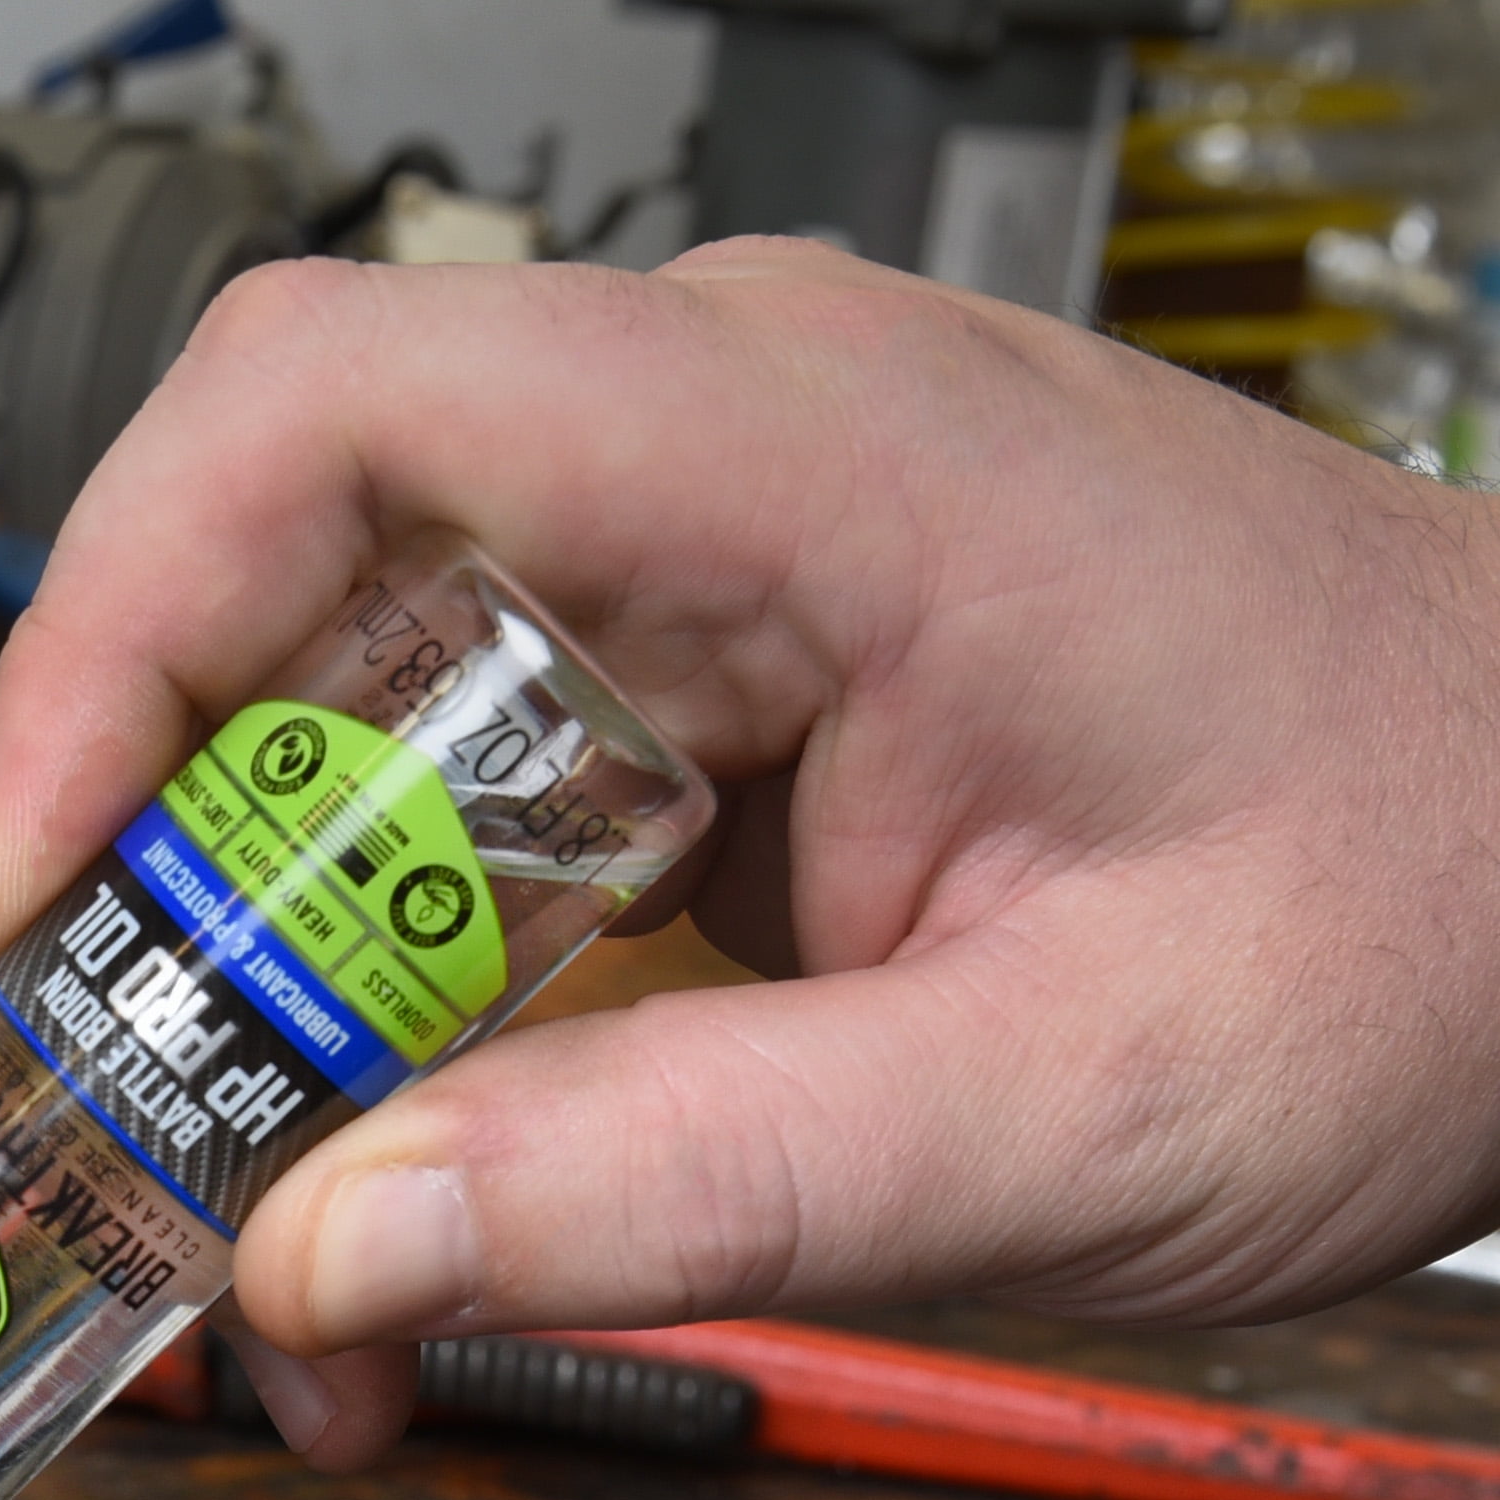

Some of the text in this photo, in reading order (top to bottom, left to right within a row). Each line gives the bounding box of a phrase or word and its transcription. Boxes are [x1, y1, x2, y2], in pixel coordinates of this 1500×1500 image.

[448, 704, 533, 786] OZ
[197, 792, 234, 833] 100%
[384, 821, 411, 848] MADE
[515, 759, 583, 839] FL
[554, 811, 631, 885] 1.8
[235, 839, 337, 942] HEAVY-DUTY
[140, 835, 351, 1056] LUBRICANT & PROTECTANT
[58, 882, 306, 1145] HP PRO OIL
[361, 968, 435, 1041] ODORLESS
[34, 966, 214, 1151] BATTLE BORN
[119, 1186, 201, 1262] CLEAN
